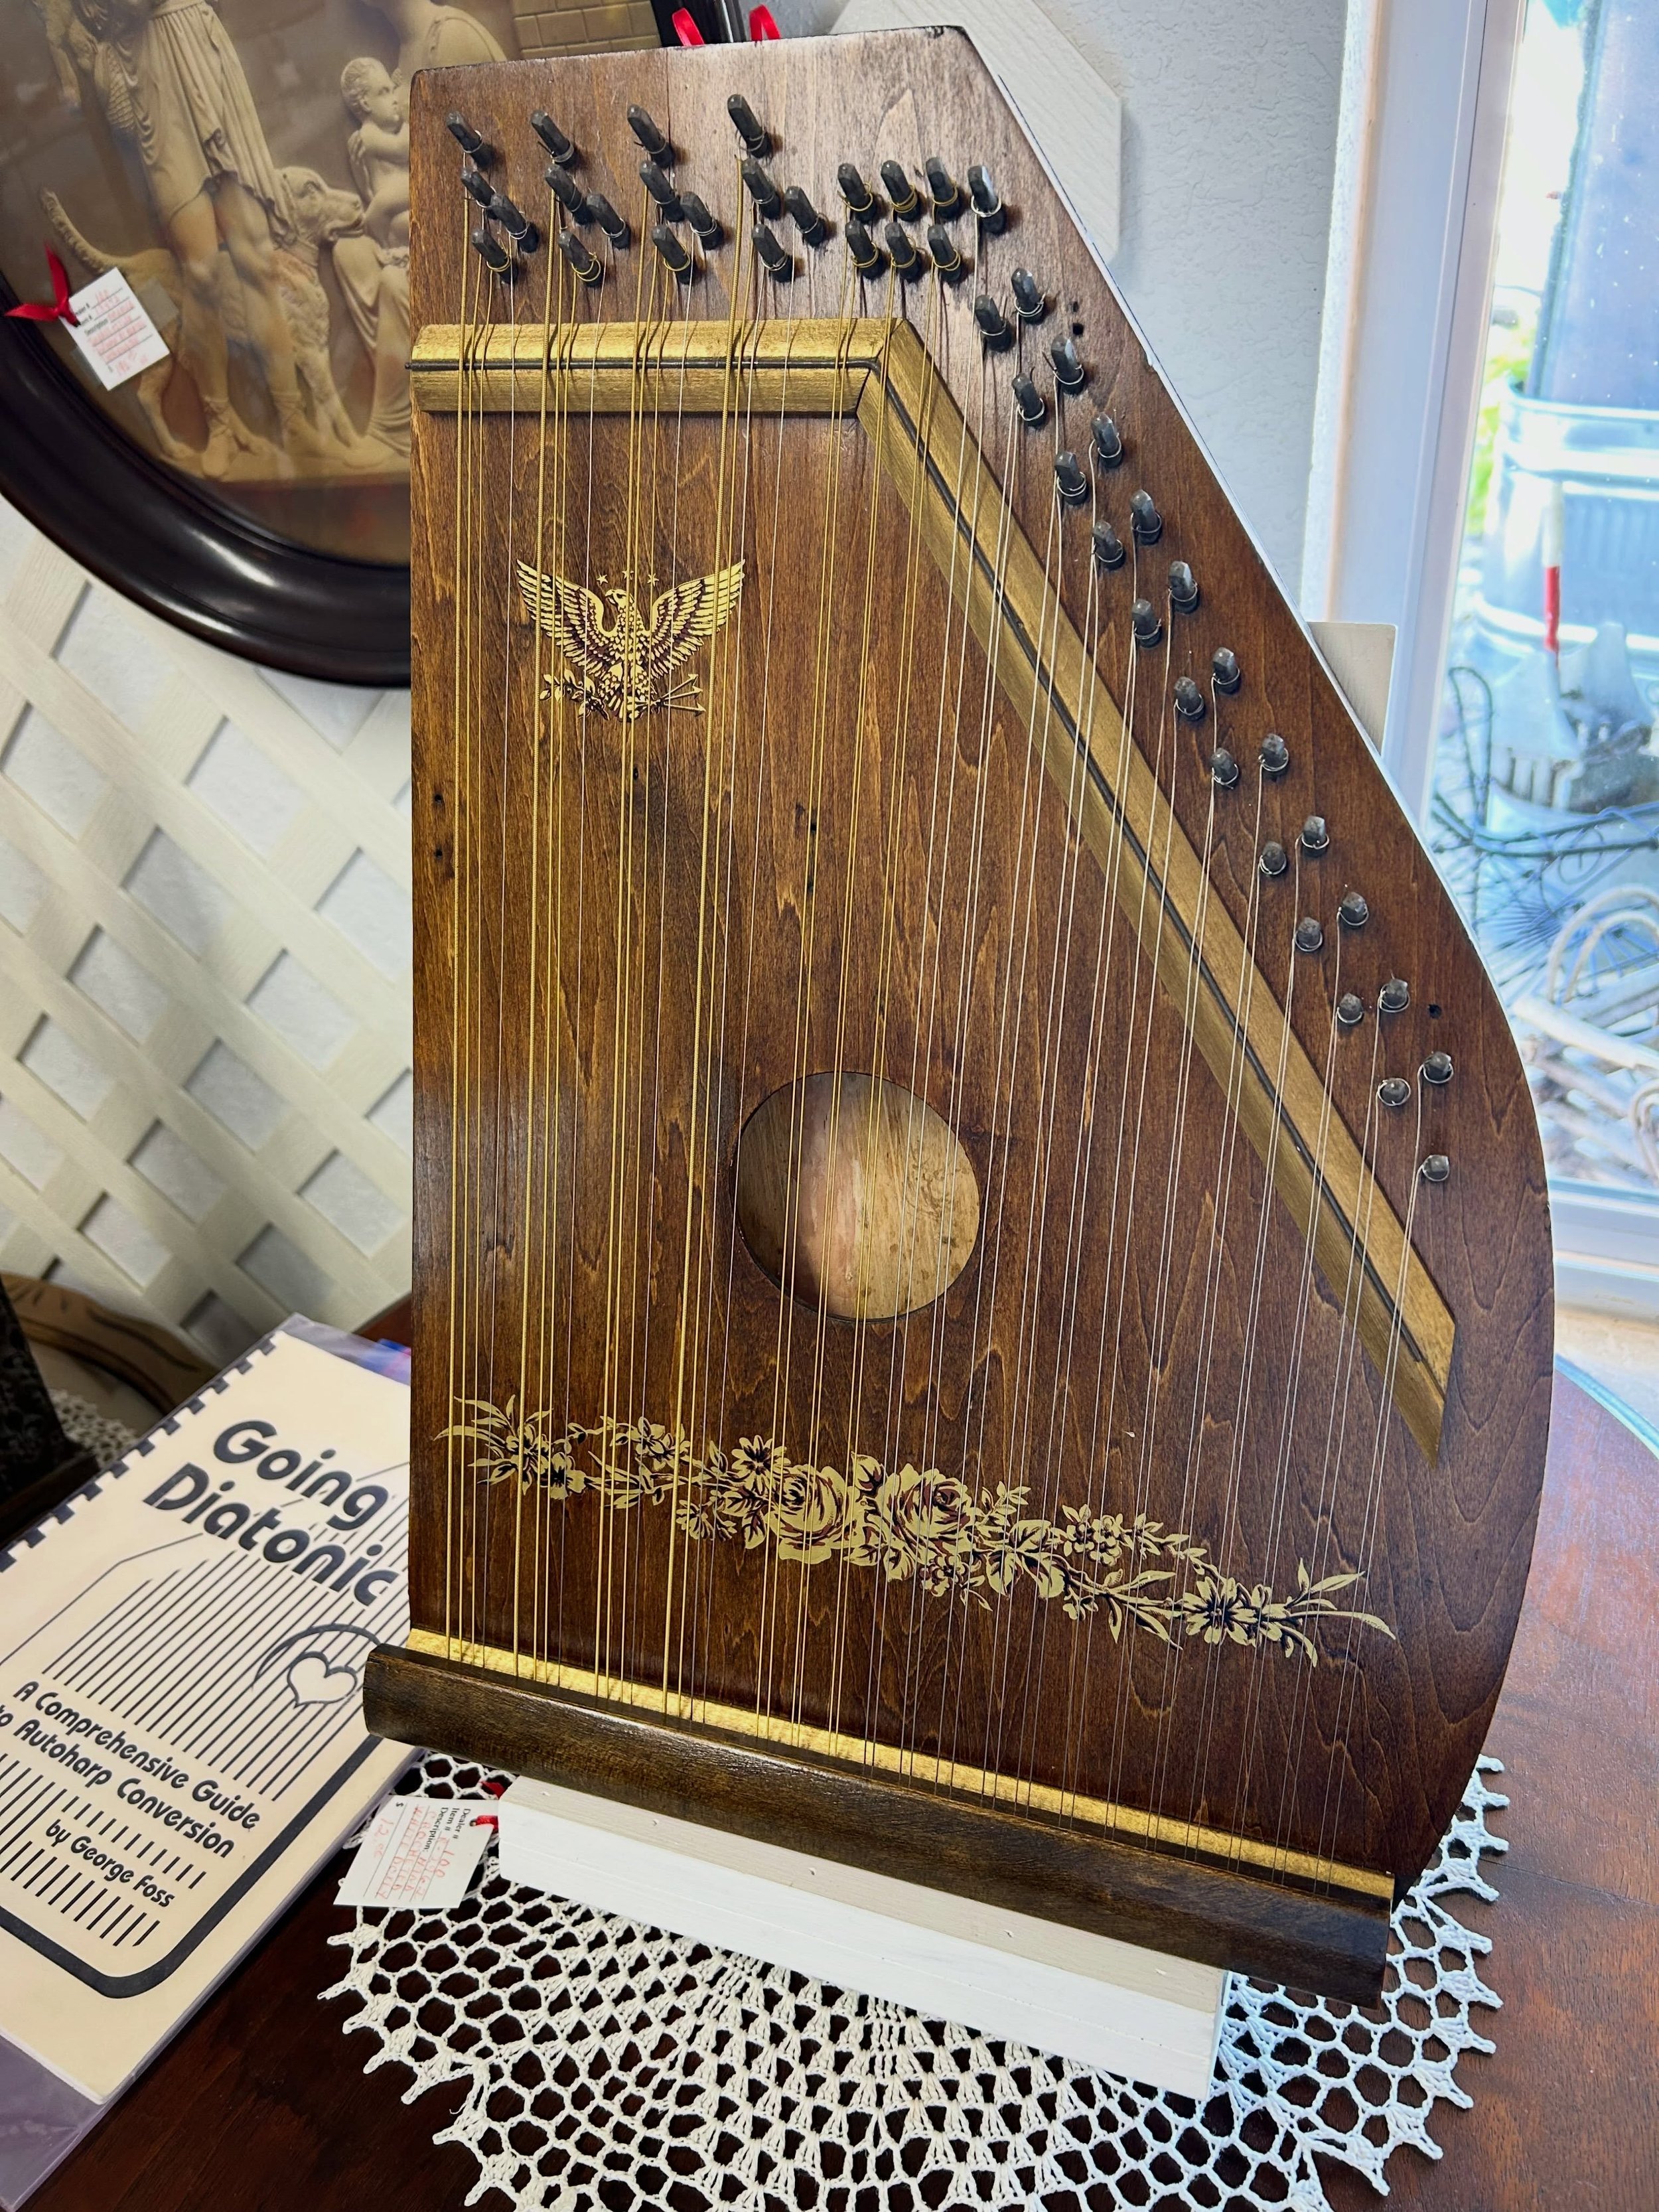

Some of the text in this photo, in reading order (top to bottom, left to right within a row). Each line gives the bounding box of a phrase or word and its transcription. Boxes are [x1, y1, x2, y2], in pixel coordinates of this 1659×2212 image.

[213, 1420, 389, 1530] Going
[143, 1463, 399, 1607] Diatonic
[13, 1681, 260, 1830] A Comprehensive Guide
[13, 1719, 112, 1789] Autoharp
[117, 1778, 235, 1858] Conversion
[45, 1819, 175, 1908] by George Foss
[423, 1807, 449, 1853] Description:
[448, 1808, 460, 1826] Item
[458, 1808, 471, 1834] Dealer
